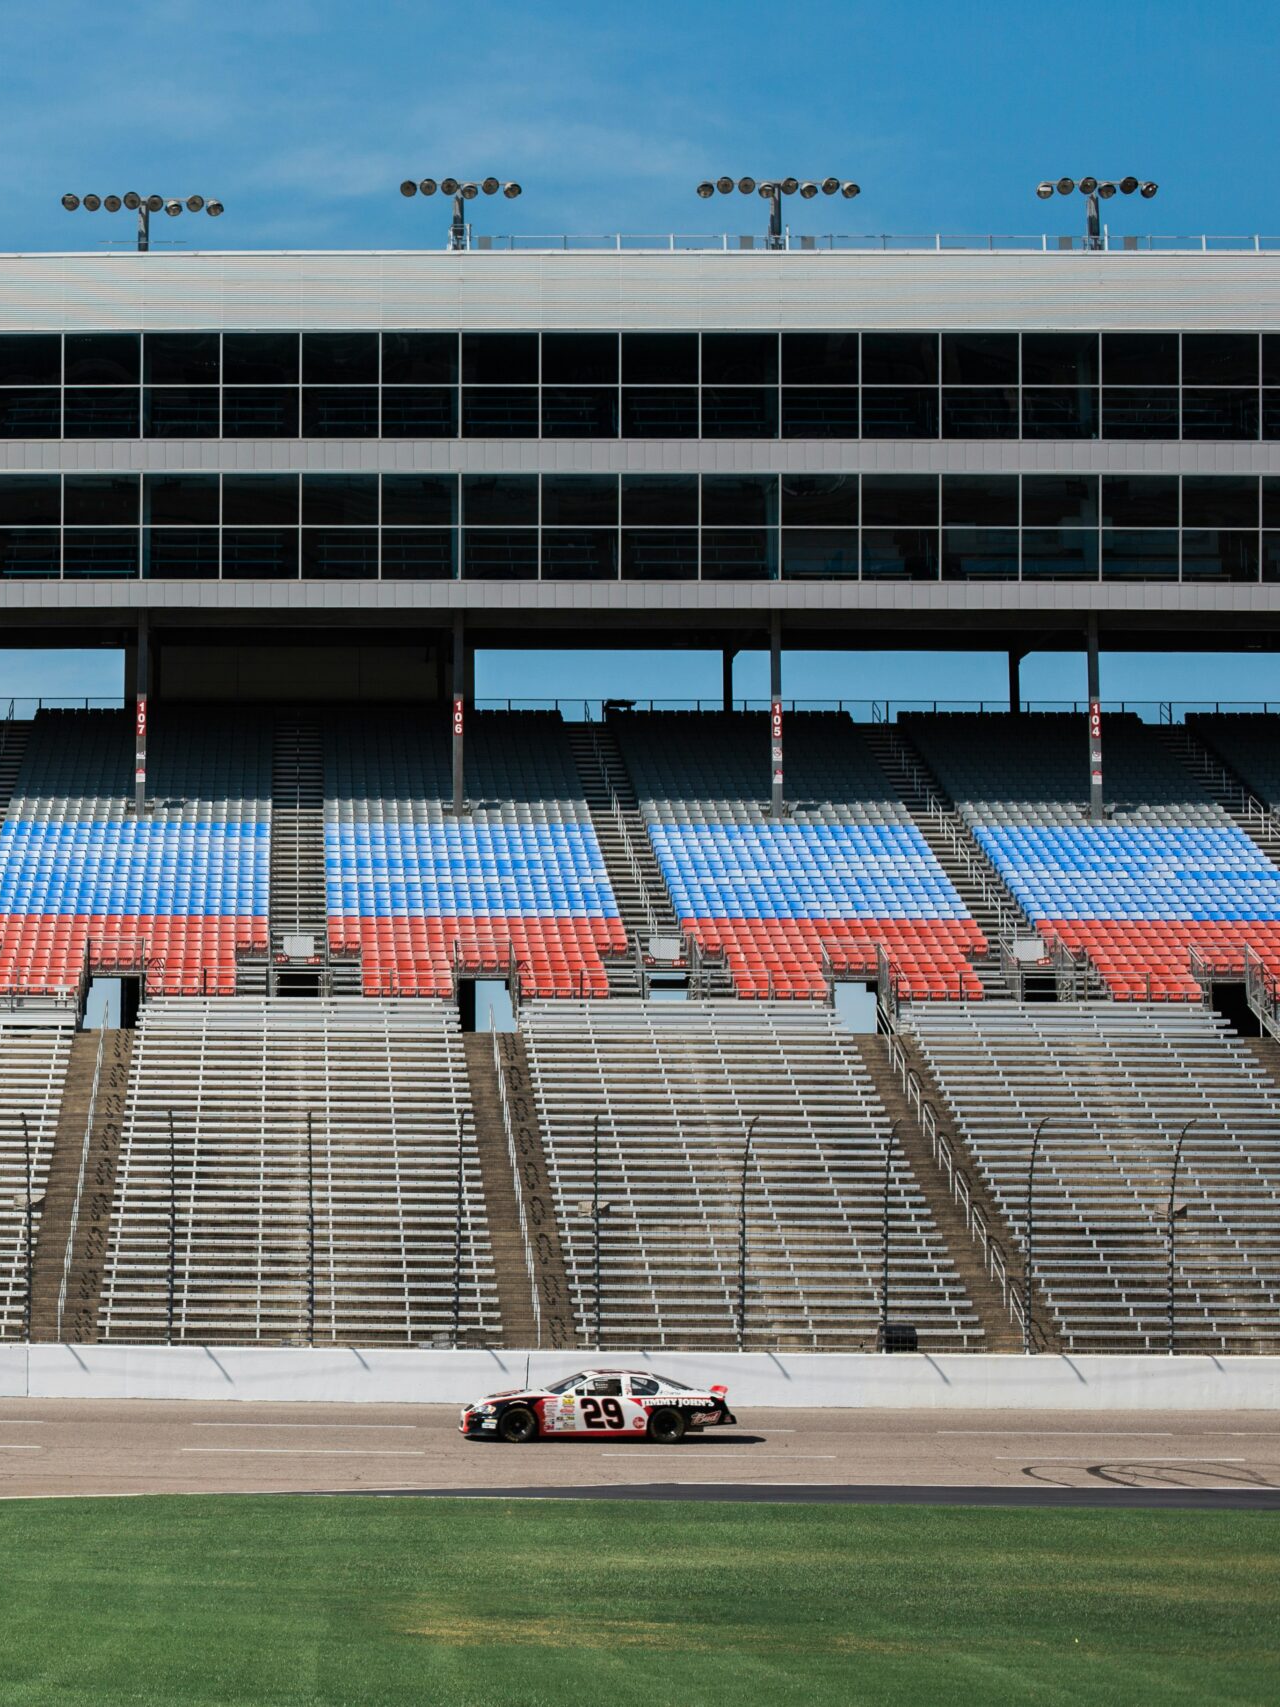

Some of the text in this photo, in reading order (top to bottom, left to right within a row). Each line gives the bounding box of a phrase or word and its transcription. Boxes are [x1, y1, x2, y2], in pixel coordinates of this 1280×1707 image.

[137, 702, 145, 734] 107
[454, 701, 462, 734] 106
[773, 703, 781, 736] 105
[1091, 703, 1100, 736] 104
[580, 1397, 625, 1429] 29
[641, 1398, 715, 1409] JIMMY JOHN'S
[692, 1411, 718, 1425] Bud
